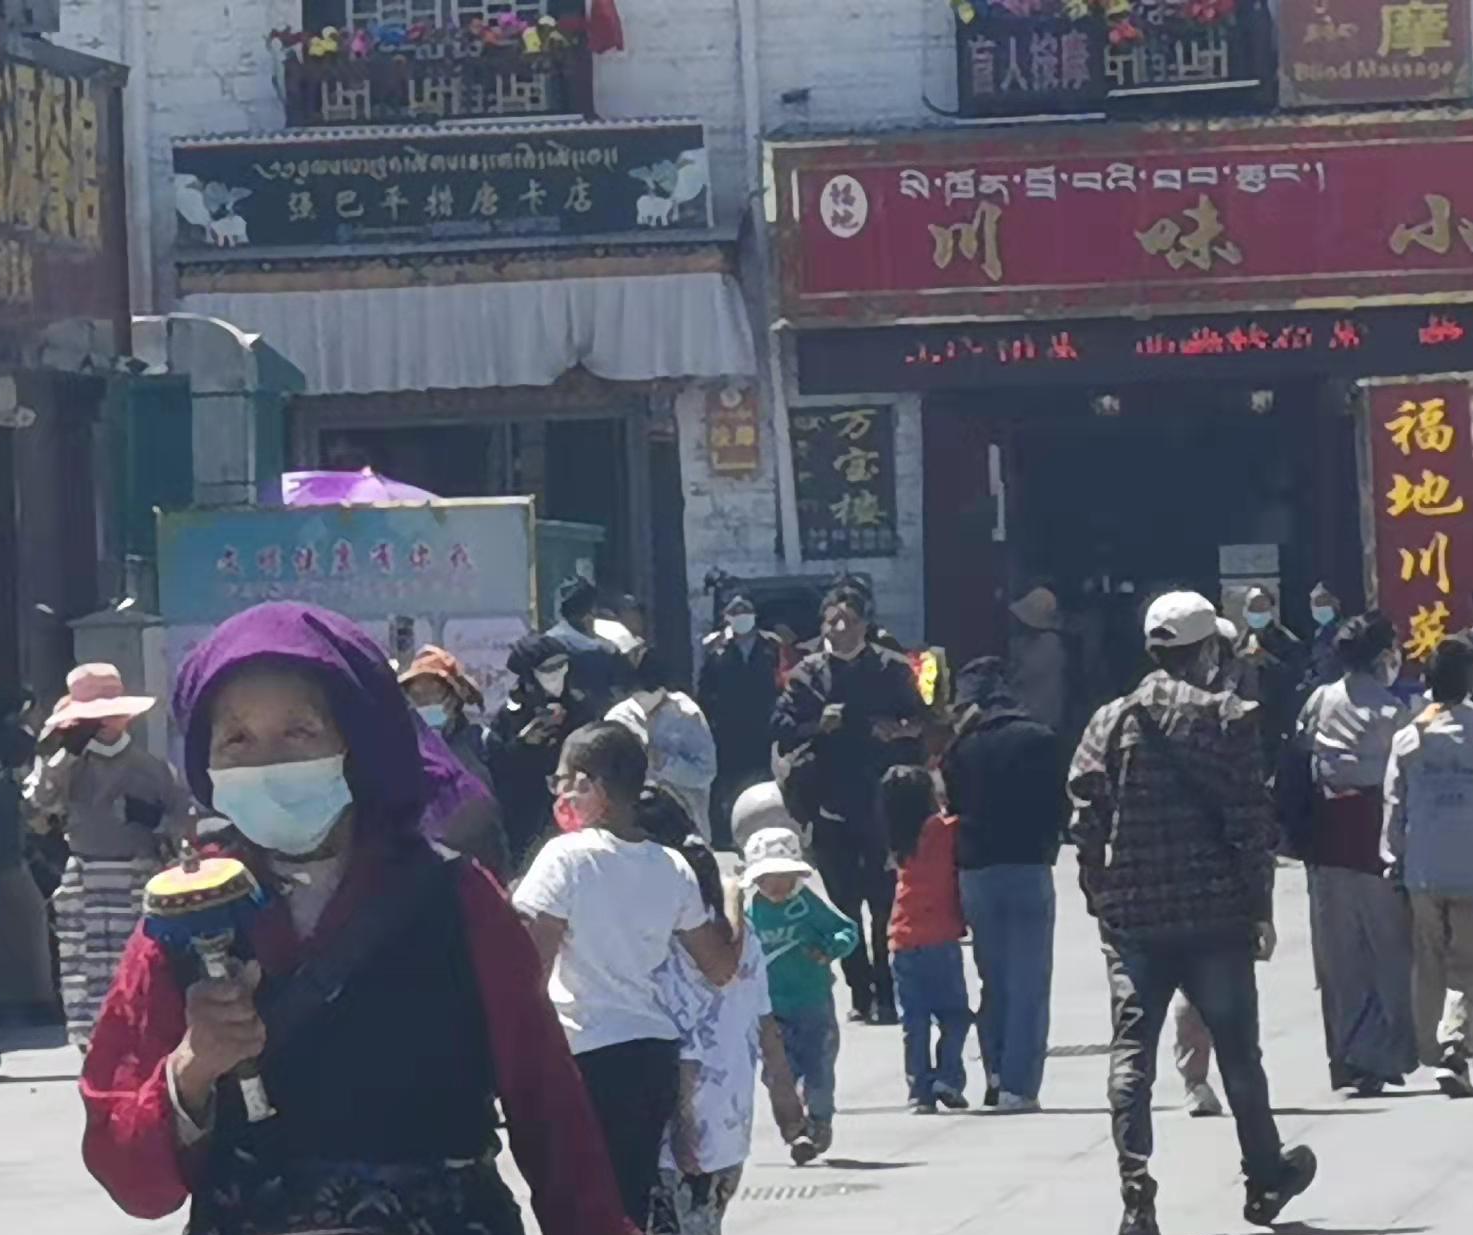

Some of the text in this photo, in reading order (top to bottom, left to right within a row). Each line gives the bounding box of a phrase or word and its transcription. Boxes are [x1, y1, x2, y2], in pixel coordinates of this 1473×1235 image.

[1293, 58, 1454, 82] Blind Massage
[929, 193, 1473, 282] 川味小
